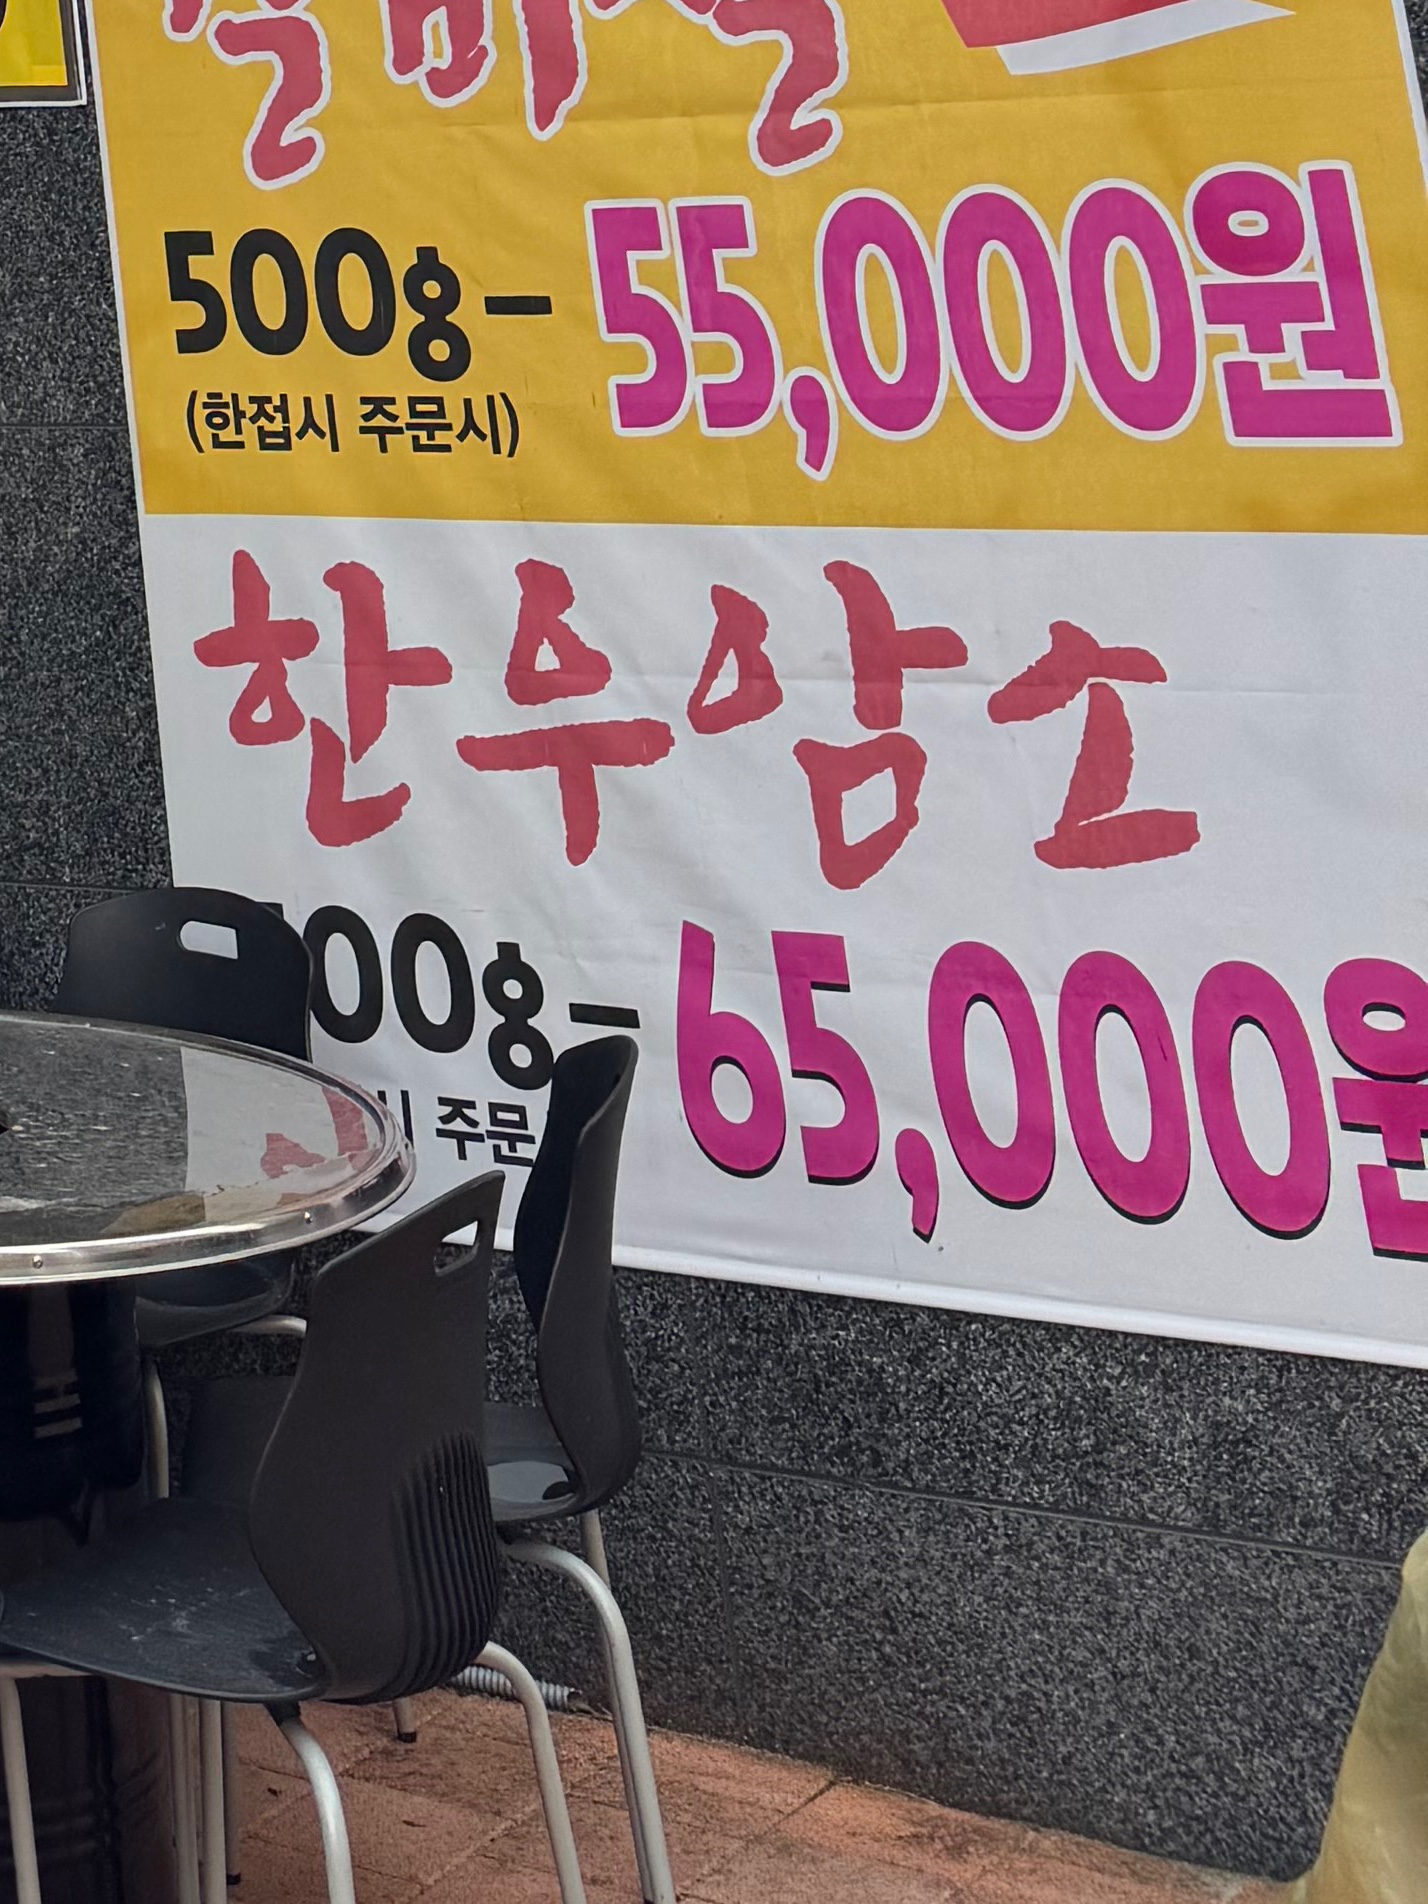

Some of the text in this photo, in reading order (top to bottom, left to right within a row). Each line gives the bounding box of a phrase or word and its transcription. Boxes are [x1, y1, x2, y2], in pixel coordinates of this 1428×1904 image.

[186, 390, 520, 458] (한접시 주문시)
[584, 162, 1402, 480] 55,000원
[192, 549, 1202, 891] 한우암소
